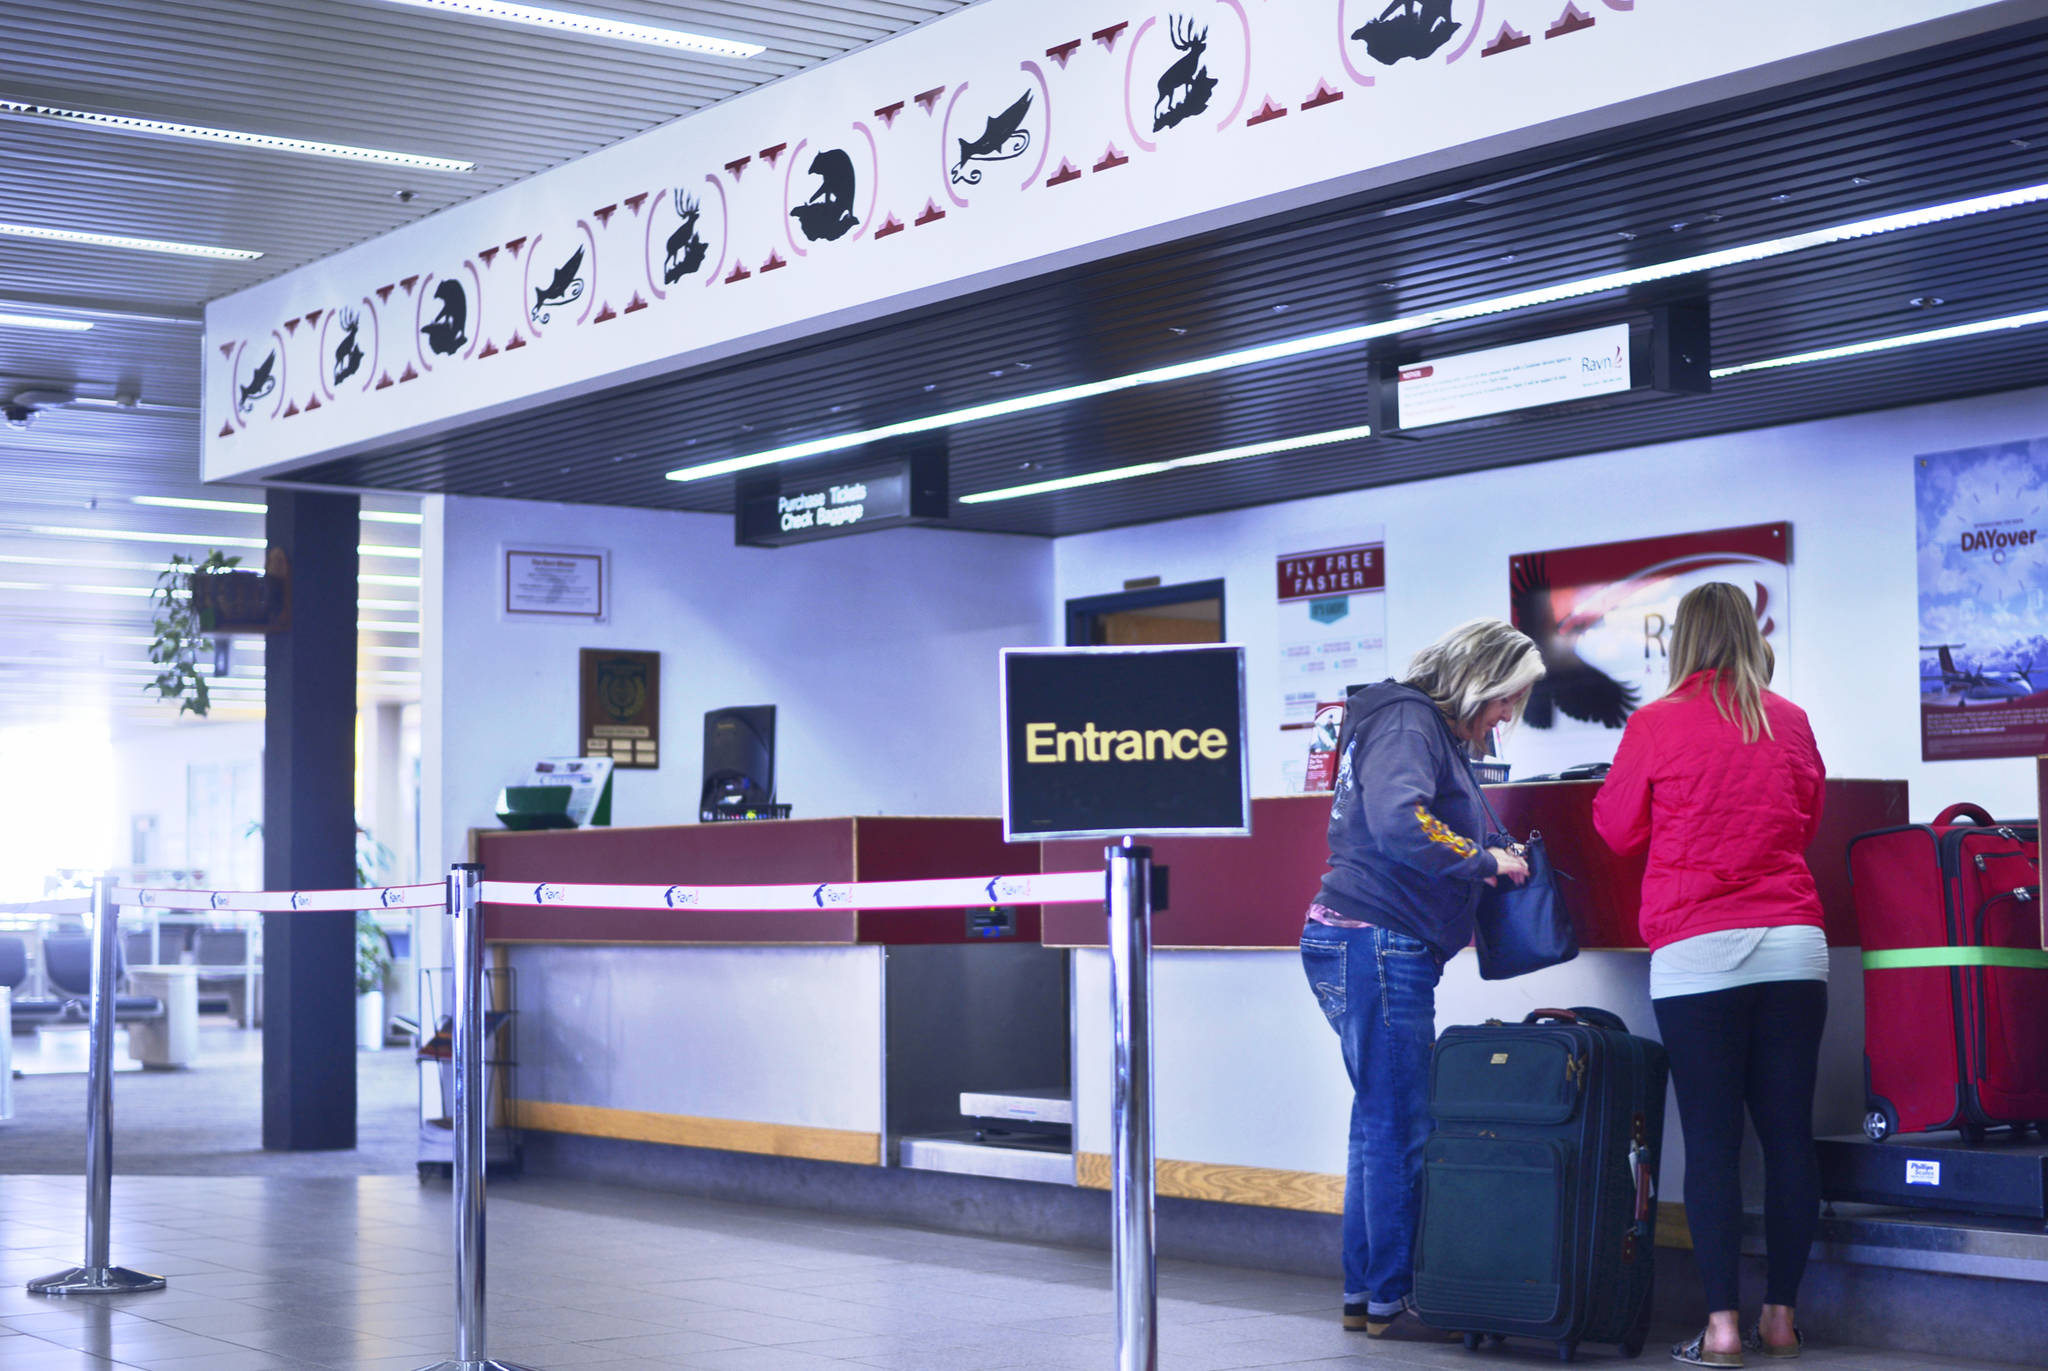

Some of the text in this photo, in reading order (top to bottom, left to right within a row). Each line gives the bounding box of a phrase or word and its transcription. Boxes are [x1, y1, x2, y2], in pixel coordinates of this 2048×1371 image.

[1581, 356, 1612, 373] Ravn
[778, 483, 867, 513] Purchase Tickets
[781, 504, 864, 531] Check Baggage
[1961, 529, 2038, 551] DAYover
[1285, 551, 1373, 577] FLY FREE
[1293, 570, 1364, 593] FASTER
[1026, 722, 1228, 763] Entrance
